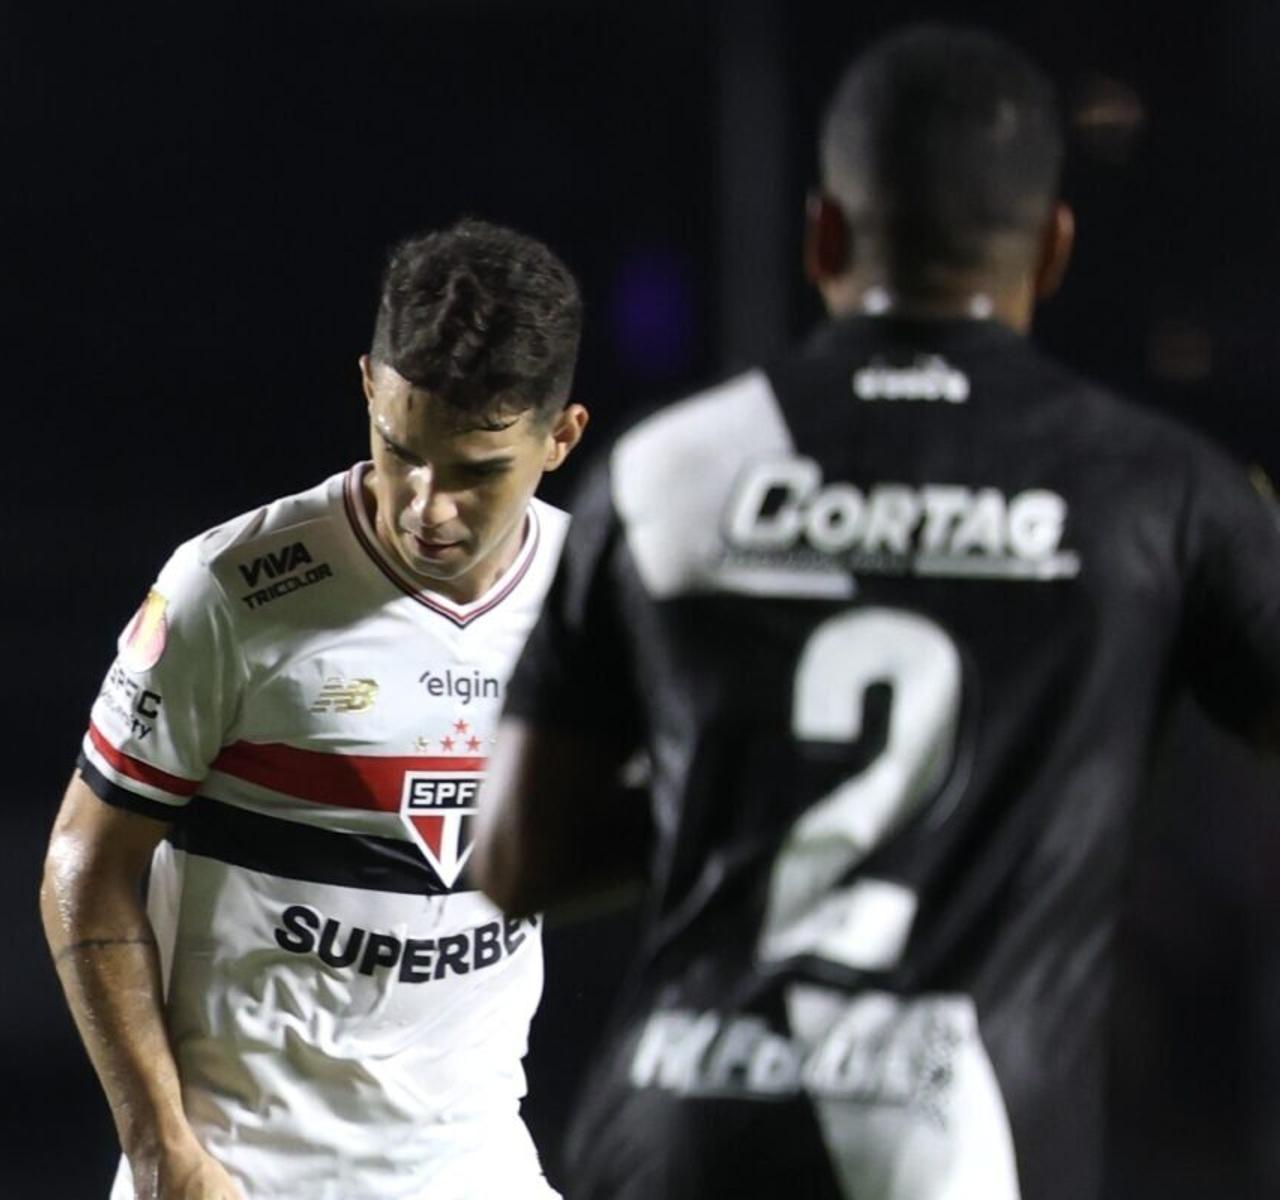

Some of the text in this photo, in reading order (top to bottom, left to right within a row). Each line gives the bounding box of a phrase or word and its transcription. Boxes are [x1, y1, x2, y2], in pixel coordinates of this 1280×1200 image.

[239, 542, 313, 588] VIVA
[242, 563, 333, 610] TRICOLOR
[762, 606, 961, 972] 2
[274, 905, 538, 984] SUPERBE
